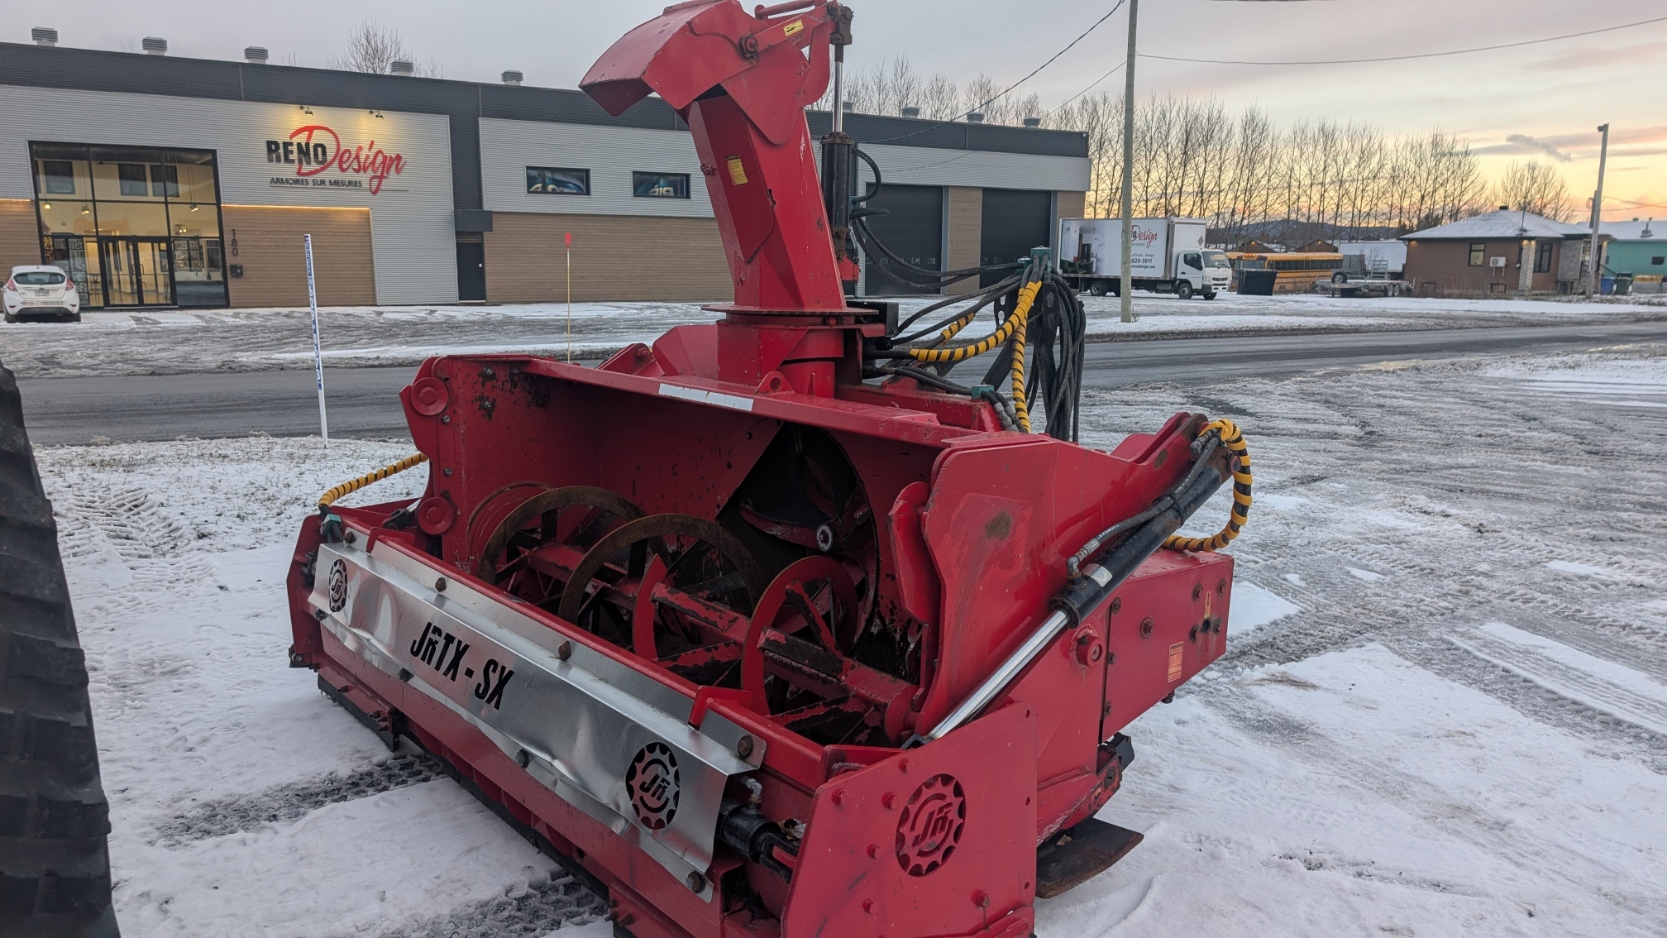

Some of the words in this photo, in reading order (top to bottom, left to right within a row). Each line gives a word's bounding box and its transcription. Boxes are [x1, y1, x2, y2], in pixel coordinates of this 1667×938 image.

[266, 140, 327, 165] RENO
[290, 125, 407, 195] Design
[270, 177, 309, 187] ARMOIRES
[312, 179, 326, 187] SUR
[329, 179, 362, 188] MESURES
[231, 228, 239, 257] 180
